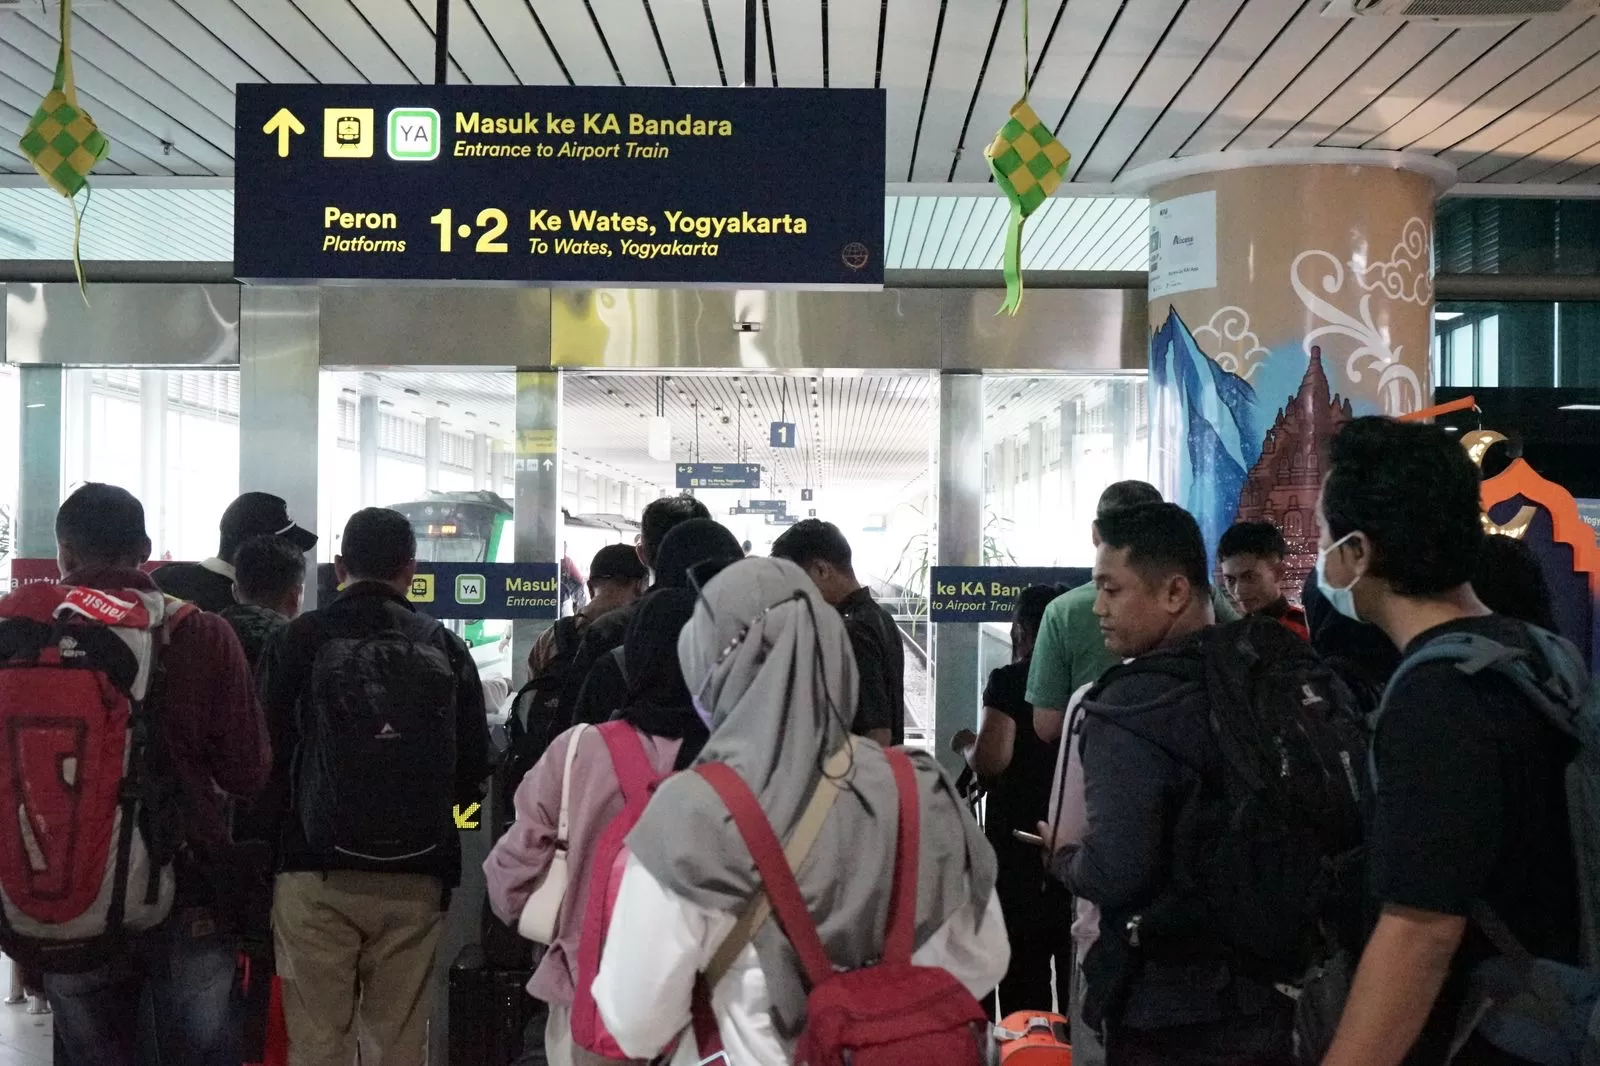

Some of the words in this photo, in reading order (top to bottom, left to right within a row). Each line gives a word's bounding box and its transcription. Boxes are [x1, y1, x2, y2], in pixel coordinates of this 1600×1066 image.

[455, 111, 540, 134] Masuk
[546, 112, 576, 135] ke
[583, 113, 621, 135] KA
[629, 113, 732, 136] Bandara
[400, 125, 429, 142] YA
[453, 140, 531, 157] Entrance
[536, 142, 554, 157] to
[557, 141, 621, 161] Airport
[625, 142, 669, 158] Train
[324, 206, 397, 229] Peron
[529, 209, 562, 231] Ke
[568, 209, 656, 236] Wates,
[664, 210, 808, 238] Yogyakarta
[323, 235, 407, 252] Platforms
[529, 238, 549, 254] To
[554, 238, 613, 257] Wates,
[620, 239, 719, 259] Yogyakarta
[778, 426, 788, 443] 1
[686, 466, 693, 474] 2
[463, 585, 477, 594] YA
[505, 577, 557, 592] Masuk
[937, 581, 956, 595] ke
[961, 582, 986, 596] KA
[991, 582, 1032, 597] Ban
[82, 593, 127, 620] ransit
[506, 596, 558, 607] Entrance
[932, 601, 943, 610] to
[945, 600, 986, 613] Airport
